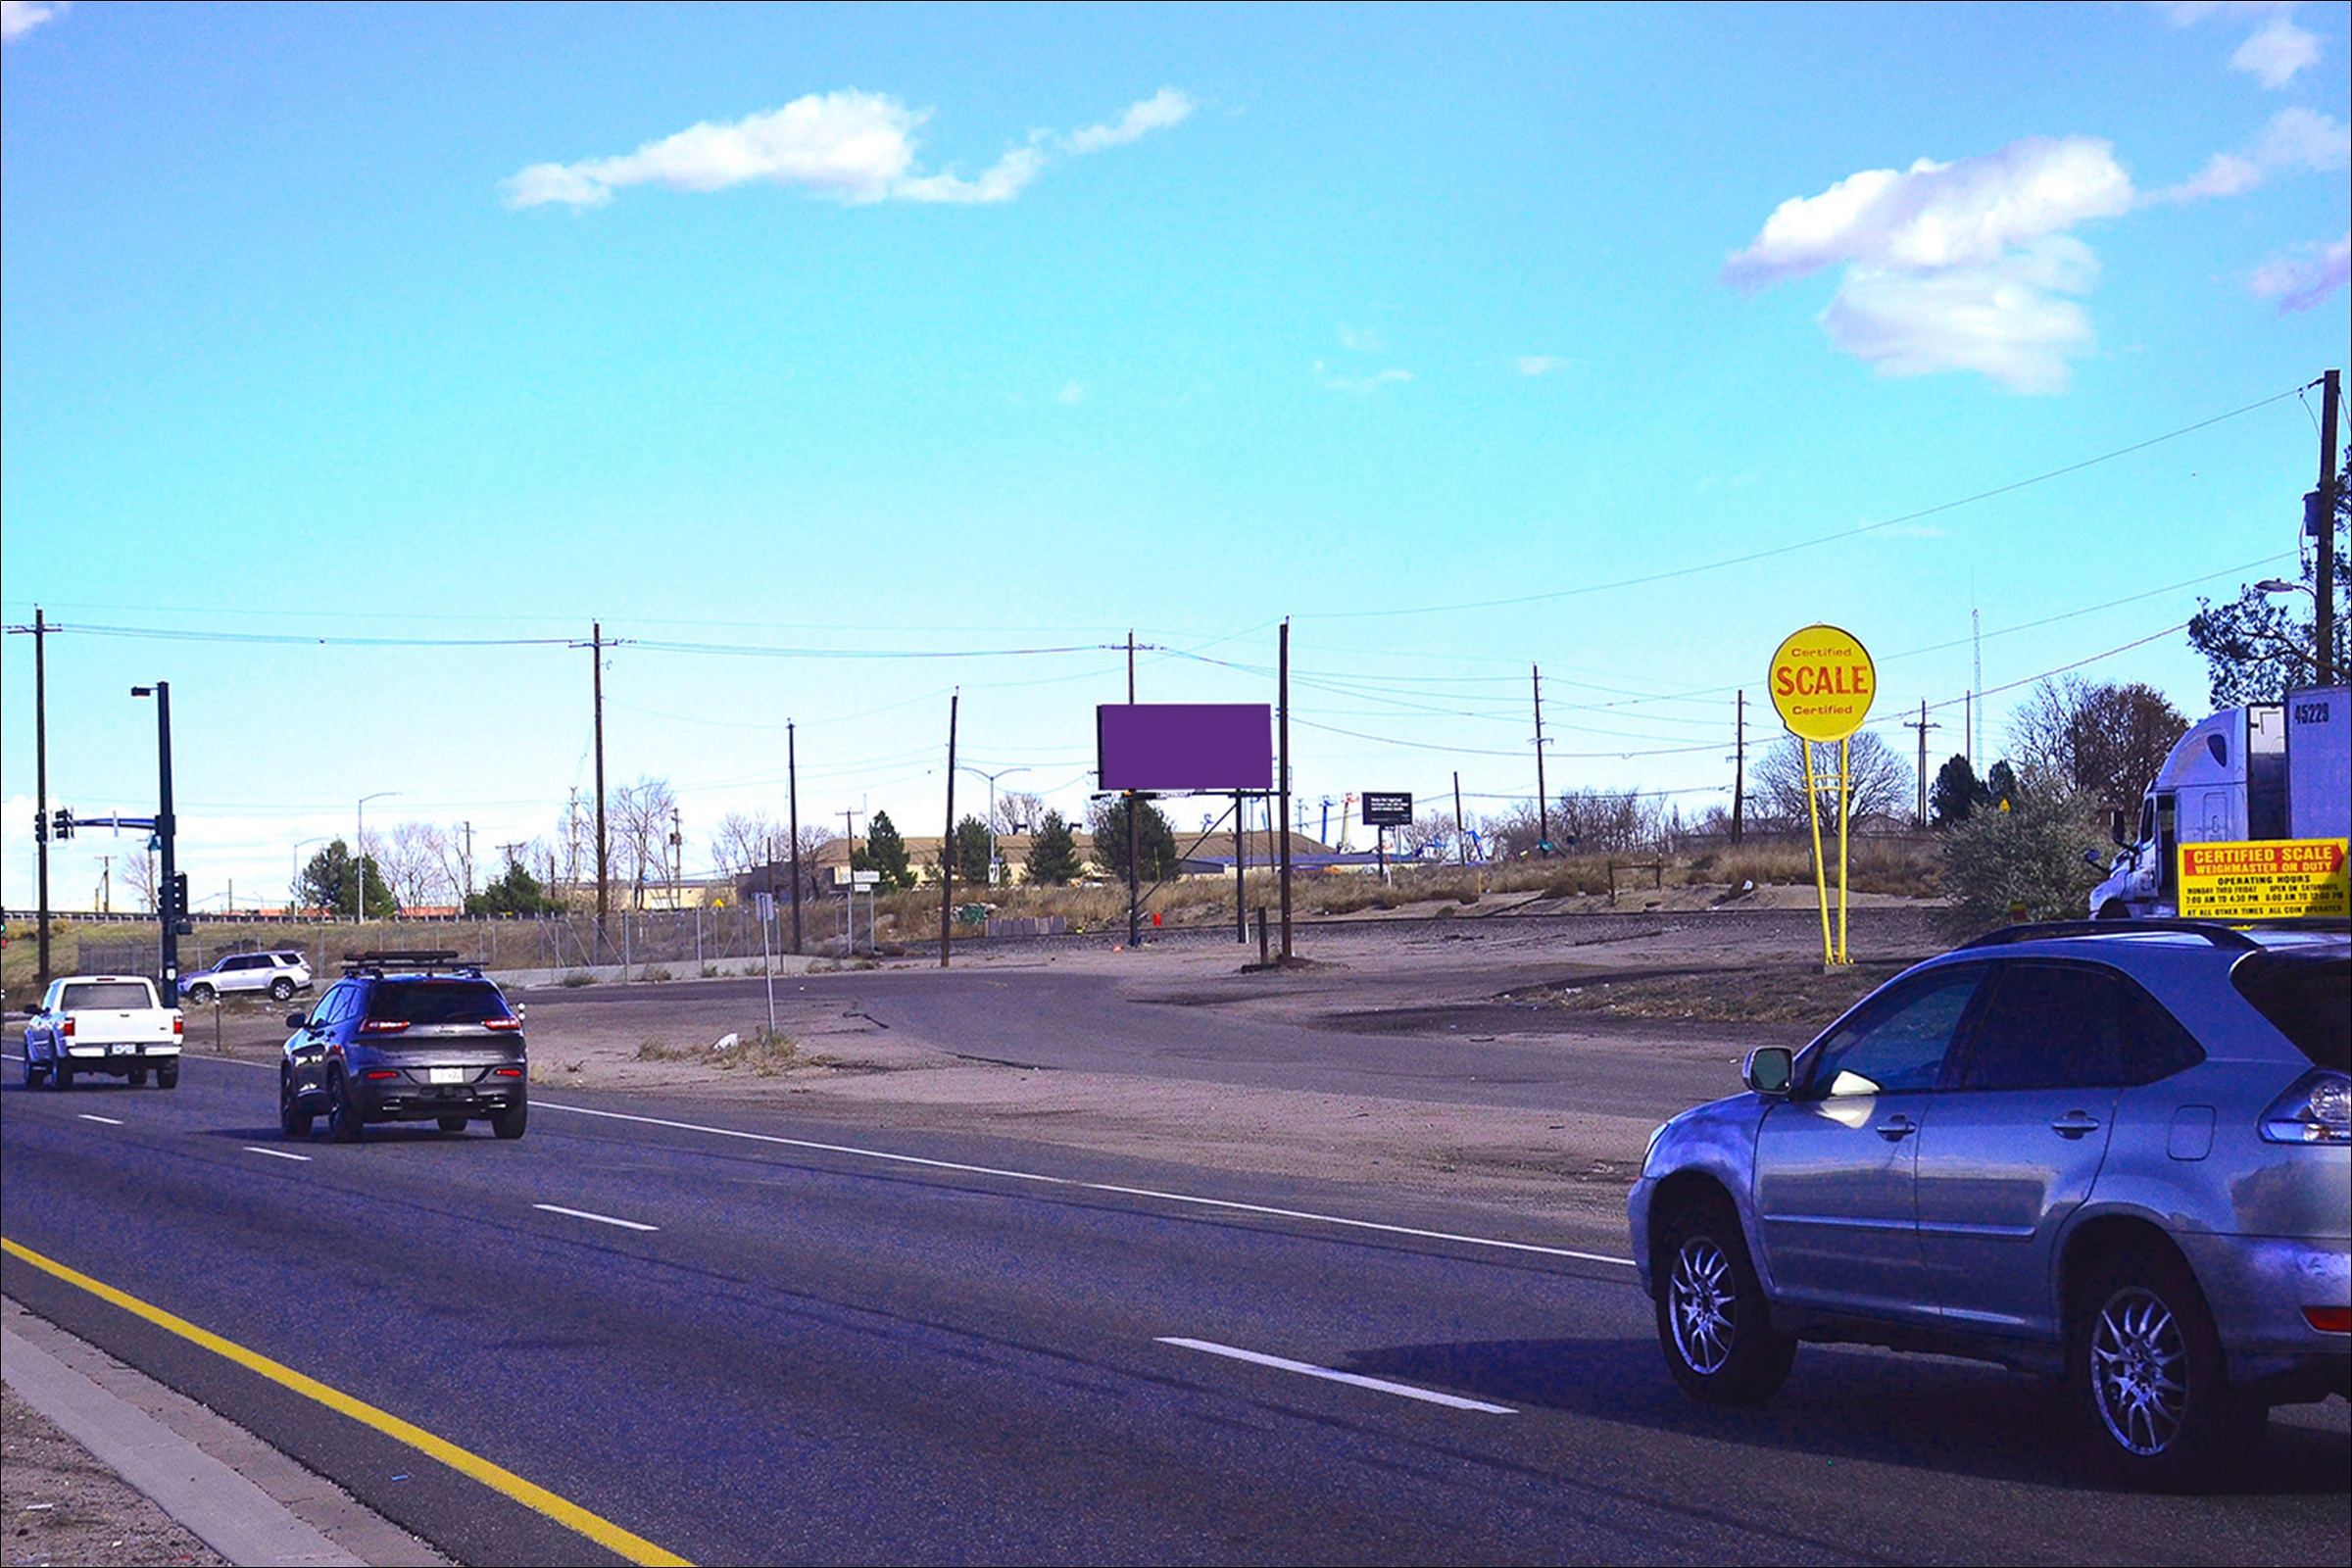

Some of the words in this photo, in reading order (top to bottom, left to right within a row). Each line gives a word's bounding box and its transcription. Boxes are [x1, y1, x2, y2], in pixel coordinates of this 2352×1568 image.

[1790, 647, 1852, 658] Certified
[1776, 665, 1869, 697] SCALE
[1791, 705, 1853, 715] Certified
[2193, 849, 2275, 863] CERTIFIED
[2281, 847, 2332, 861] SCALE
[2194, 862, 2278, 874] WEIGHMASTER
[2281, 862, 2298, 872] ON
[2302, 860, 2331, 872] DUTY
[2218, 875, 2273, 886] OPERATING
[2277, 874, 2311, 884] HOURS
[2204, 895, 2216, 904] AM
[2248, 894, 2259, 903] PM
[2187, 907, 2197, 916] AT
[2215, 906, 2238, 915] OTHER
[2240, 906, 2264, 914] TIMES
[2269, 905, 2281, 913] ALL
